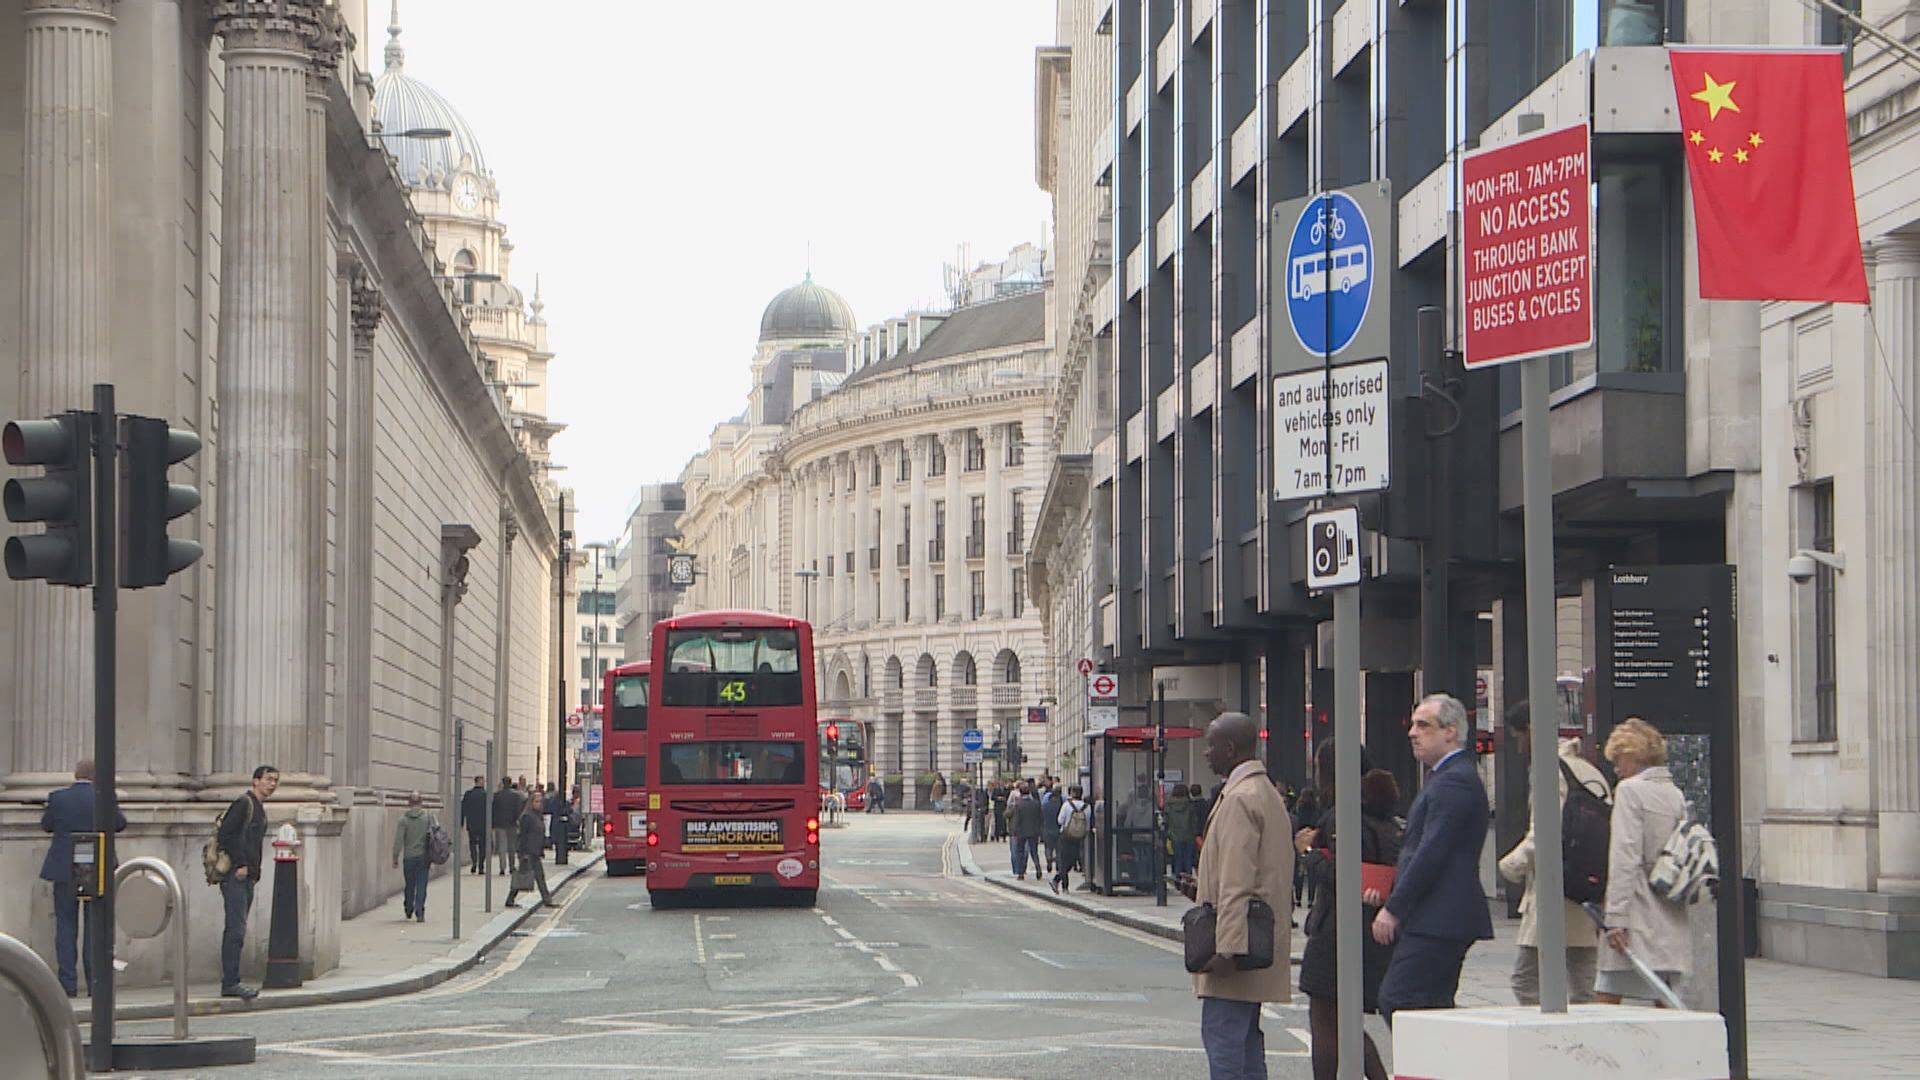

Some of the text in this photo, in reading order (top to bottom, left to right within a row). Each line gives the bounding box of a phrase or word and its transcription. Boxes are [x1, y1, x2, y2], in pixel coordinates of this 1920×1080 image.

[1466, 151, 1585, 207] MON-FRI, 7AM-7PM
[1480, 187, 1570, 238] NO ACCESS
[1473, 226, 1578, 273] THROUGH BANK
[1467, 255, 1586, 304] JUNCTION EXCEPT
[1473, 287, 1581, 332] BUSES & CYCLES
[1279, 372, 1383, 407] and authorised
[1284, 402, 1376, 433] vehicles only
[1300, 437, 1328, 459] Mon
[1341, 432, 1360, 454] Fri
[1294, 468, 1322, 490] 7am
[1335, 464, 1366, 488] 7pm
[719, 681, 746, 702] 43
[687, 821, 779, 832] BUS ADVERTISING
[717, 832, 779, 843] NORWICH
